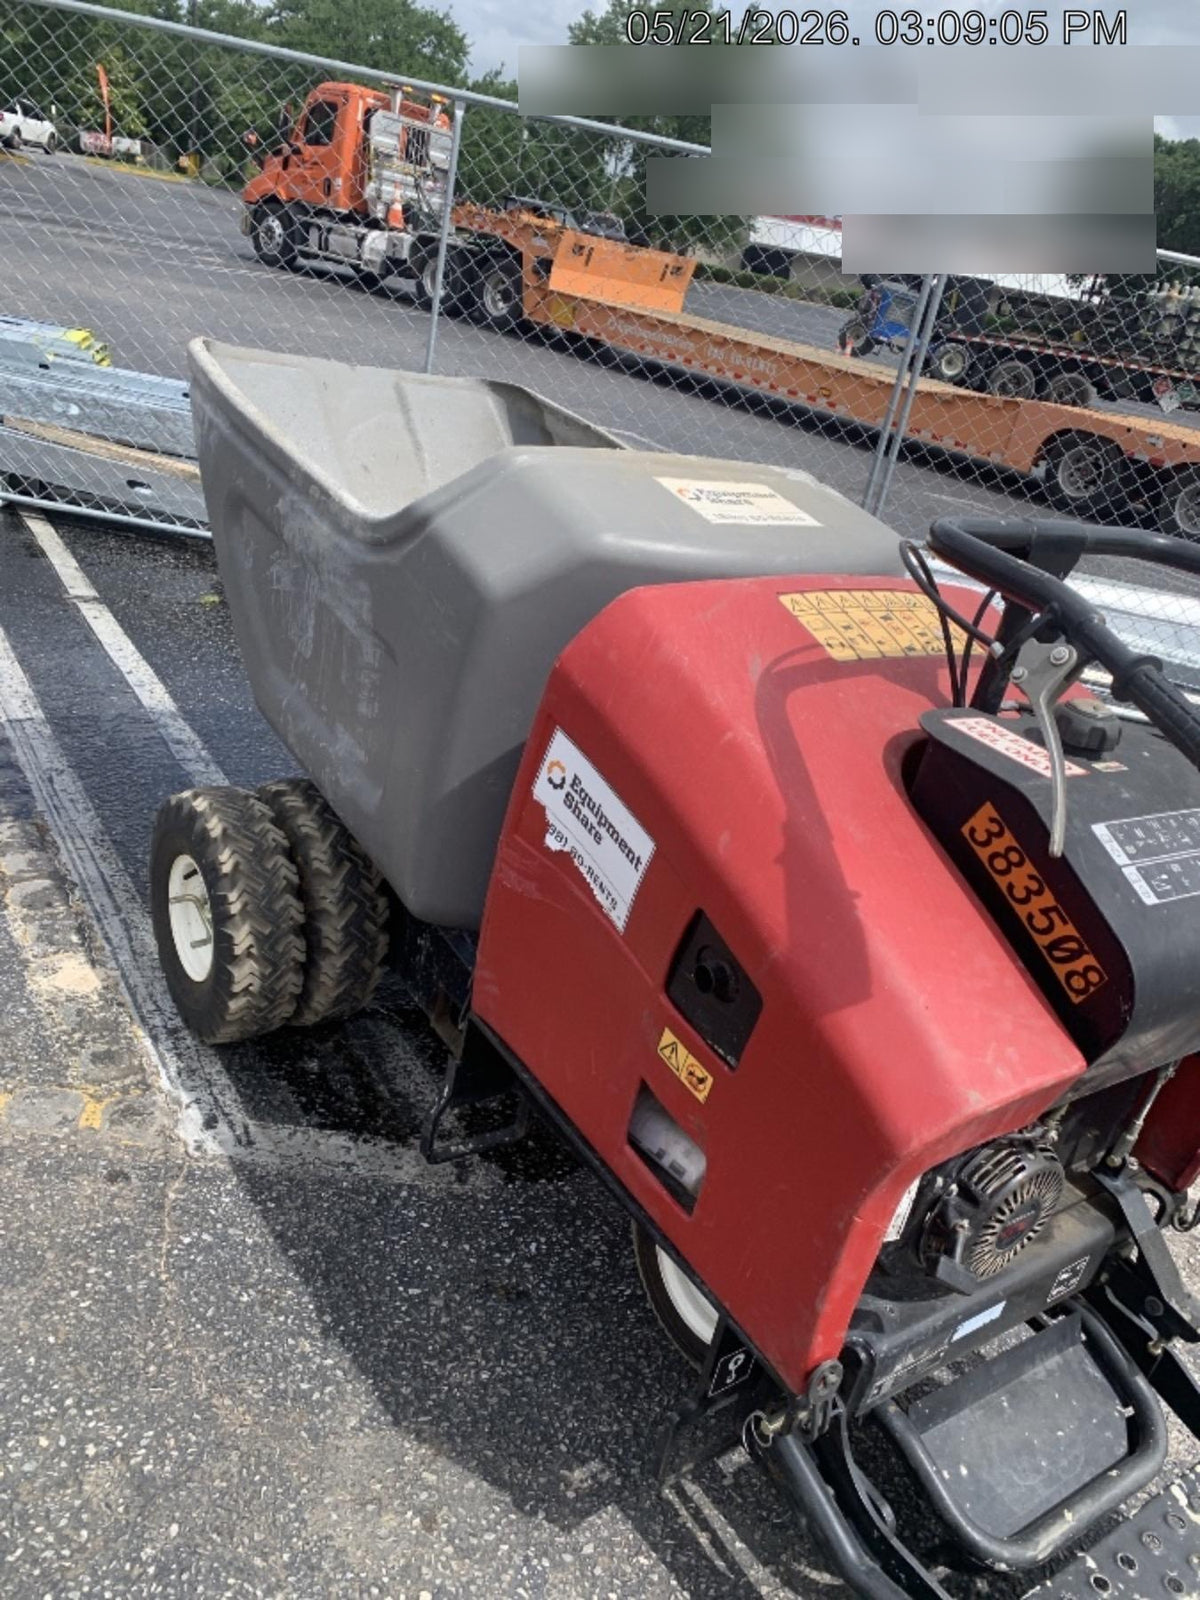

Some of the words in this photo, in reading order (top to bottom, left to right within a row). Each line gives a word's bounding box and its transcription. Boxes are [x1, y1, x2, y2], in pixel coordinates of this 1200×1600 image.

[563, 791, 603, 846] Share
[569, 773, 643, 873] Equipment
[968, 816, 1101, 996] 383508
